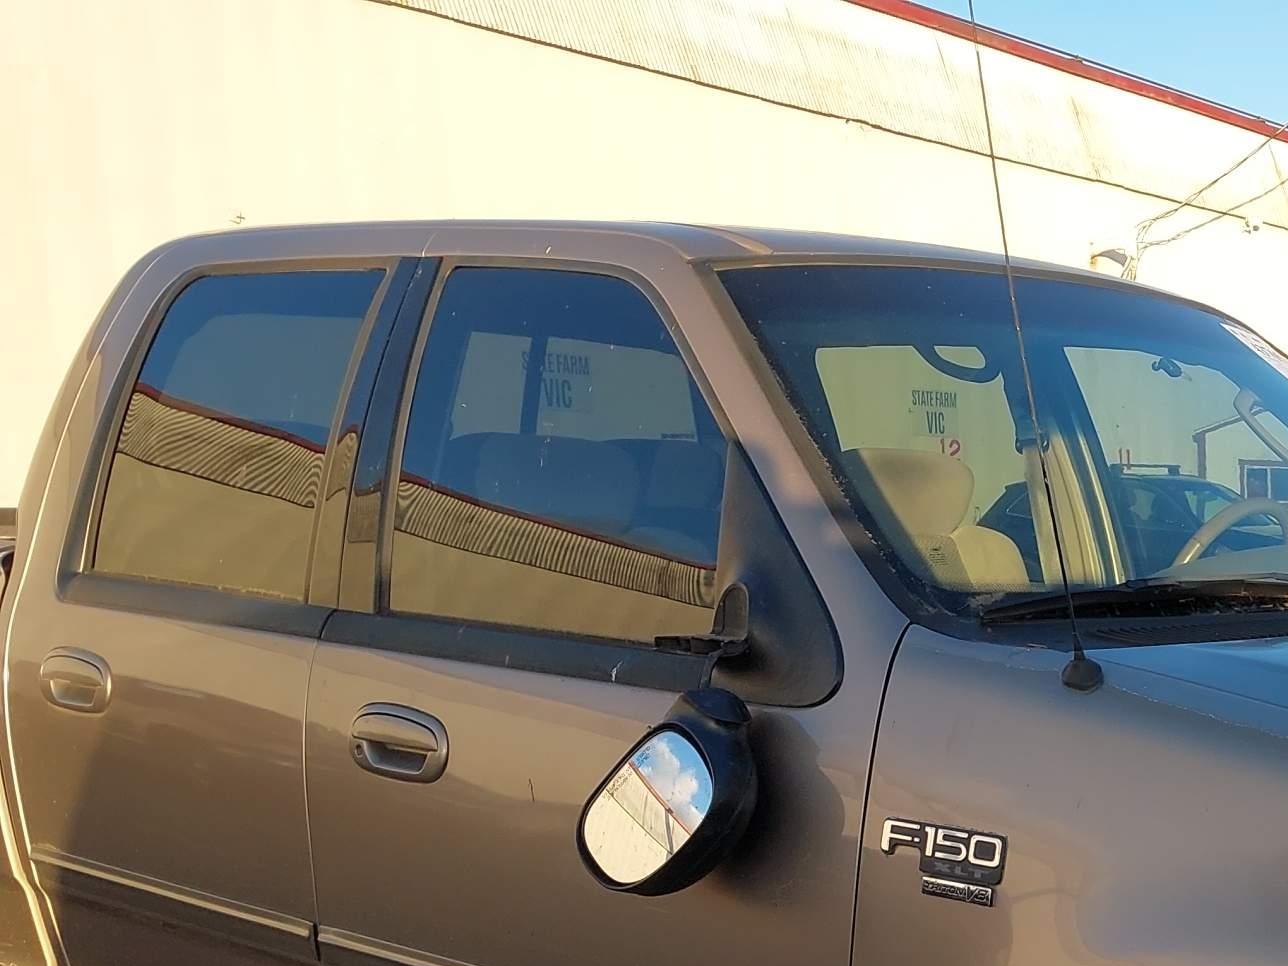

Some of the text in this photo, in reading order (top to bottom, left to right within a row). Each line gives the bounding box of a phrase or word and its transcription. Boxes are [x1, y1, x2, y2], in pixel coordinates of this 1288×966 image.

[556, 353, 590, 375] FARM
[543, 378, 572, 409] VIC
[911, 389, 957, 409] STATE FARM
[926, 410, 945, 434] VIC
[880, 819, 1003, 868] F-150
[933, 861, 990, 879] XLT
